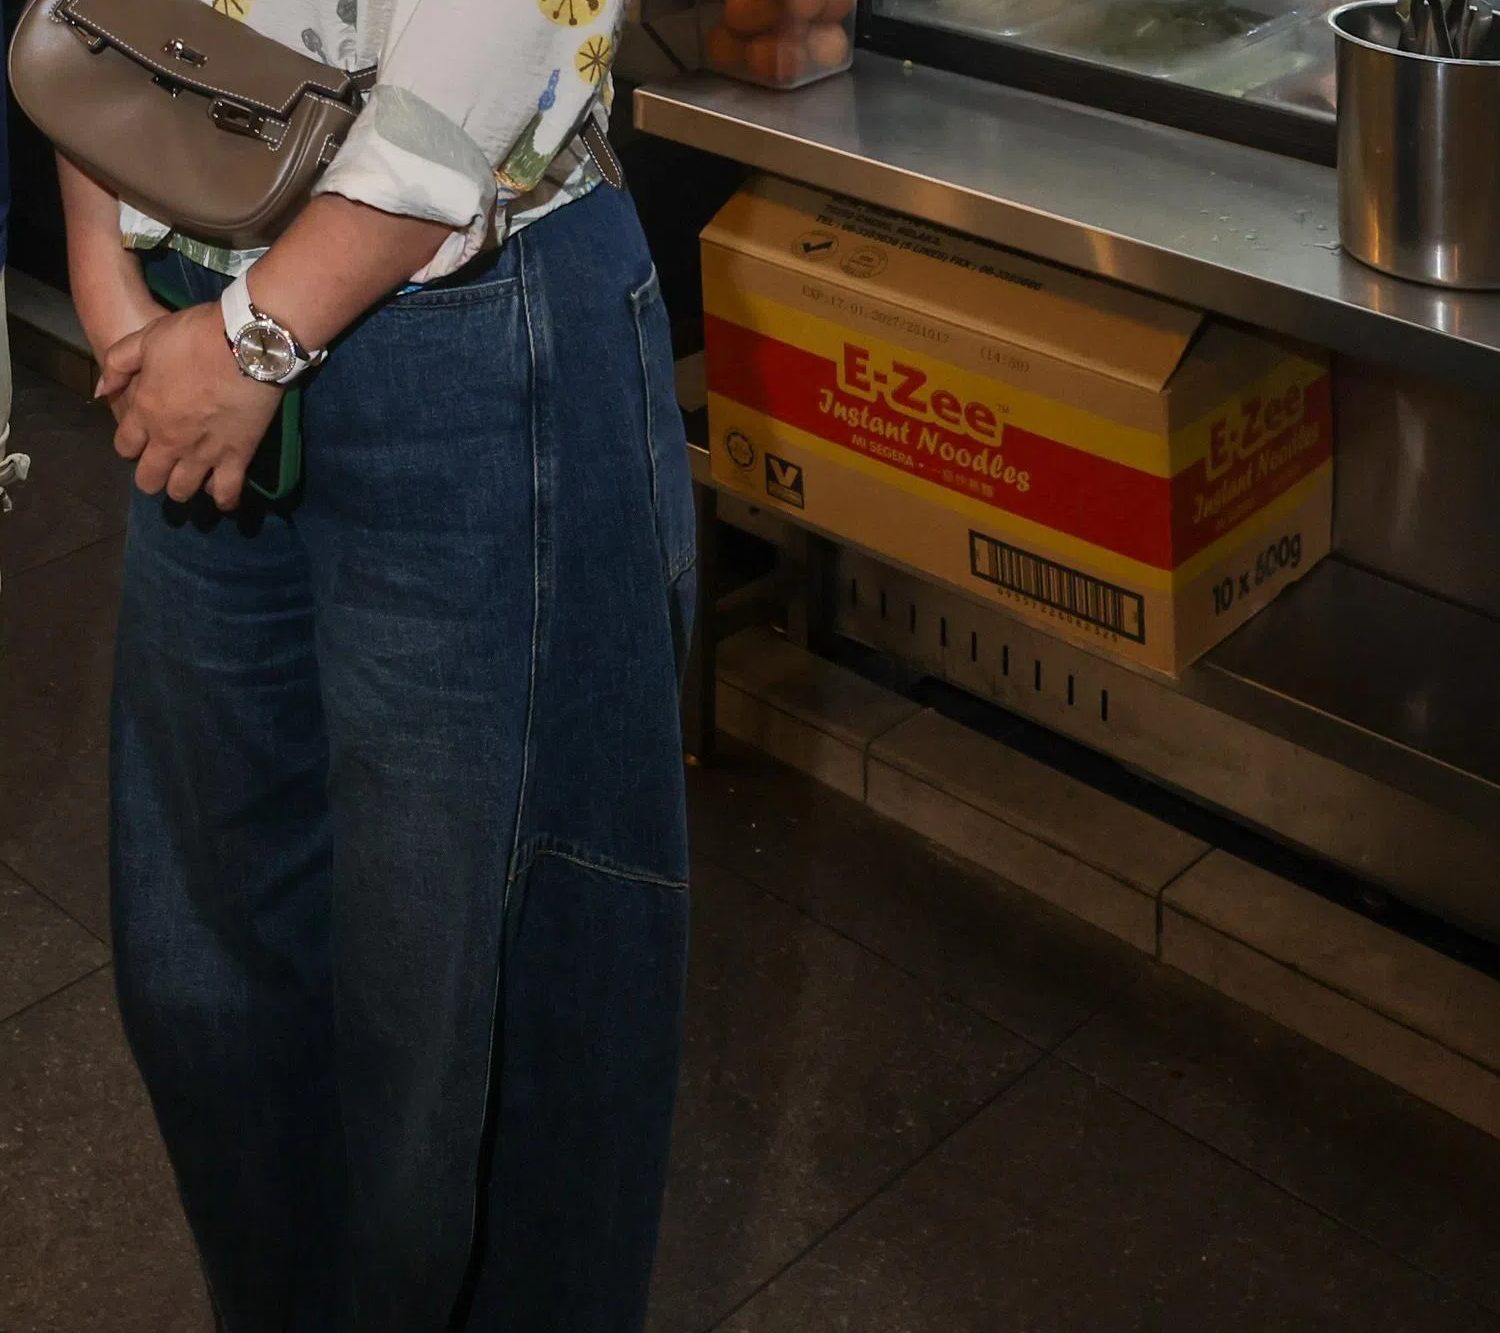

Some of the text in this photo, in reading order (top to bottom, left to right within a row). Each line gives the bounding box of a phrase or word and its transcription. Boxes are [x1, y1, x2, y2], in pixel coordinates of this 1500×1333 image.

[840, 339, 1000, 440] E-Zee
[817, 387, 912, 446] Instant
[916, 426, 1031, 493] Noodles
[869, 438, 914, 469] SEGERA
[1212, 576, 1234, 618] 10
